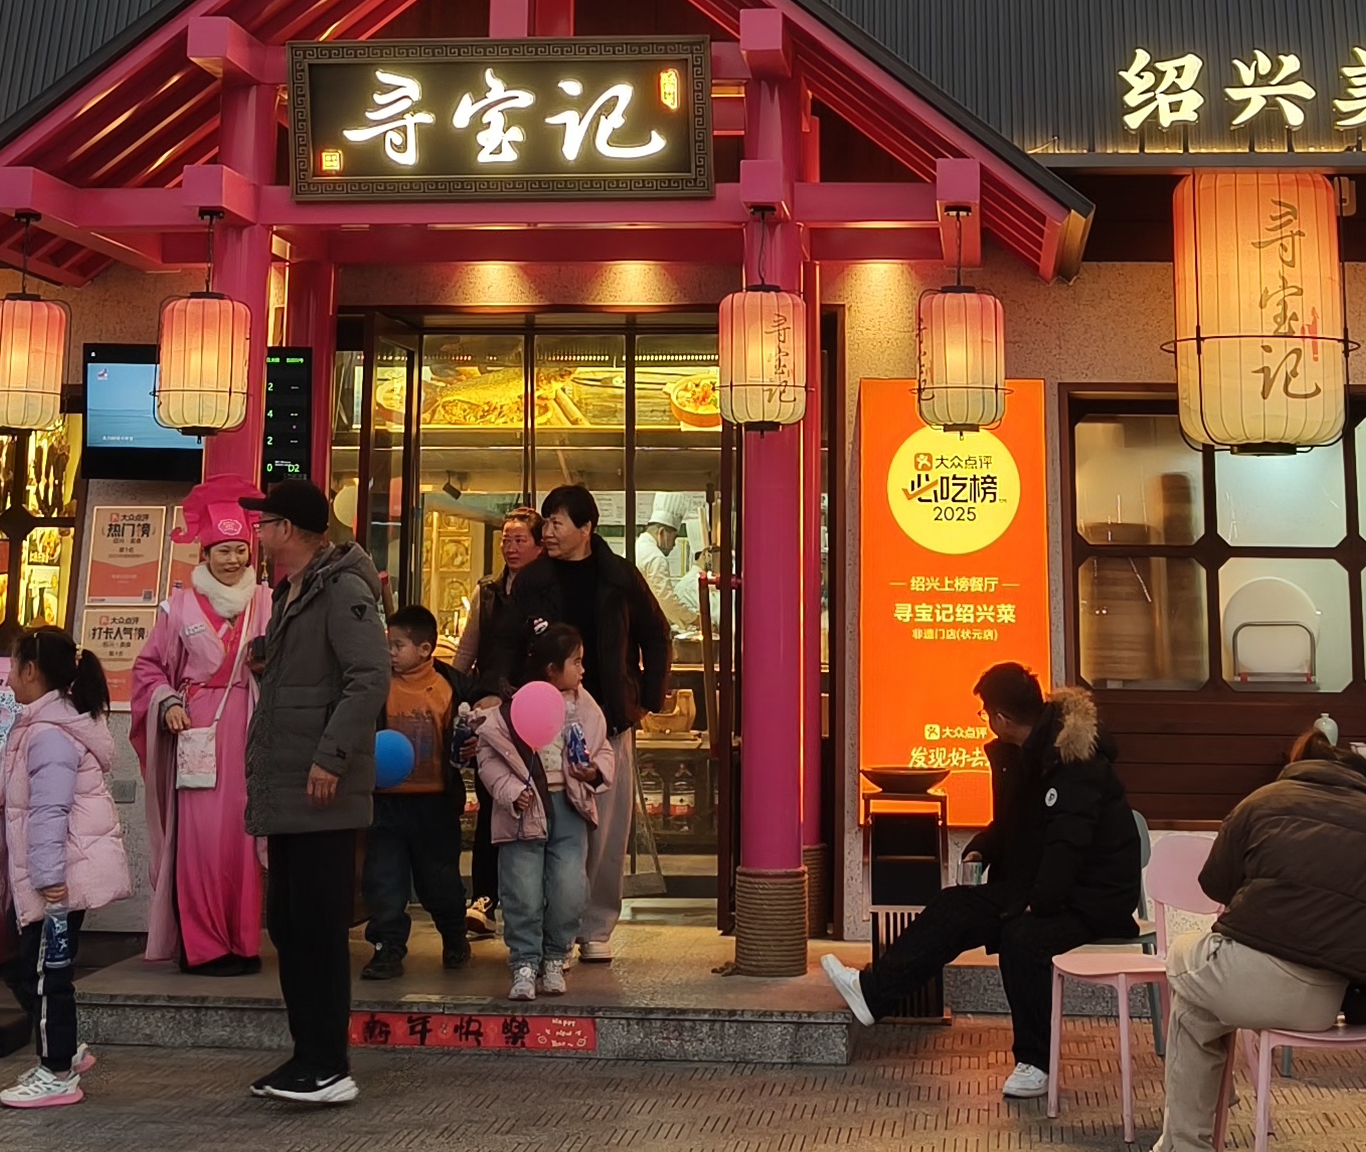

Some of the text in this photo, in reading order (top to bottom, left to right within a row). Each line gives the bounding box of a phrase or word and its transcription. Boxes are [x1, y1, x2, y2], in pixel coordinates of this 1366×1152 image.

[343, 69, 666, 165] 寻宝记
[1251, 198, 1321, 399] 寻宝记
[764, 313, 796, 403] 寻宝记
[935, 455, 992, 469] 大众点评
[901, 474, 997, 503] 必吃榜
[933, 506, 976, 521] 2025
[107, 523, 150, 537] 热门榜
[910, 576, 999, 592] 绍兴上榜餐厅
[894, 603, 1016, 623] 寻宝记绍兴菜
[942, 726, 987, 739] 大众点评
[909, 745, 991, 768] 发现好去
[363, 1013, 530, 1047] 新年快樂
